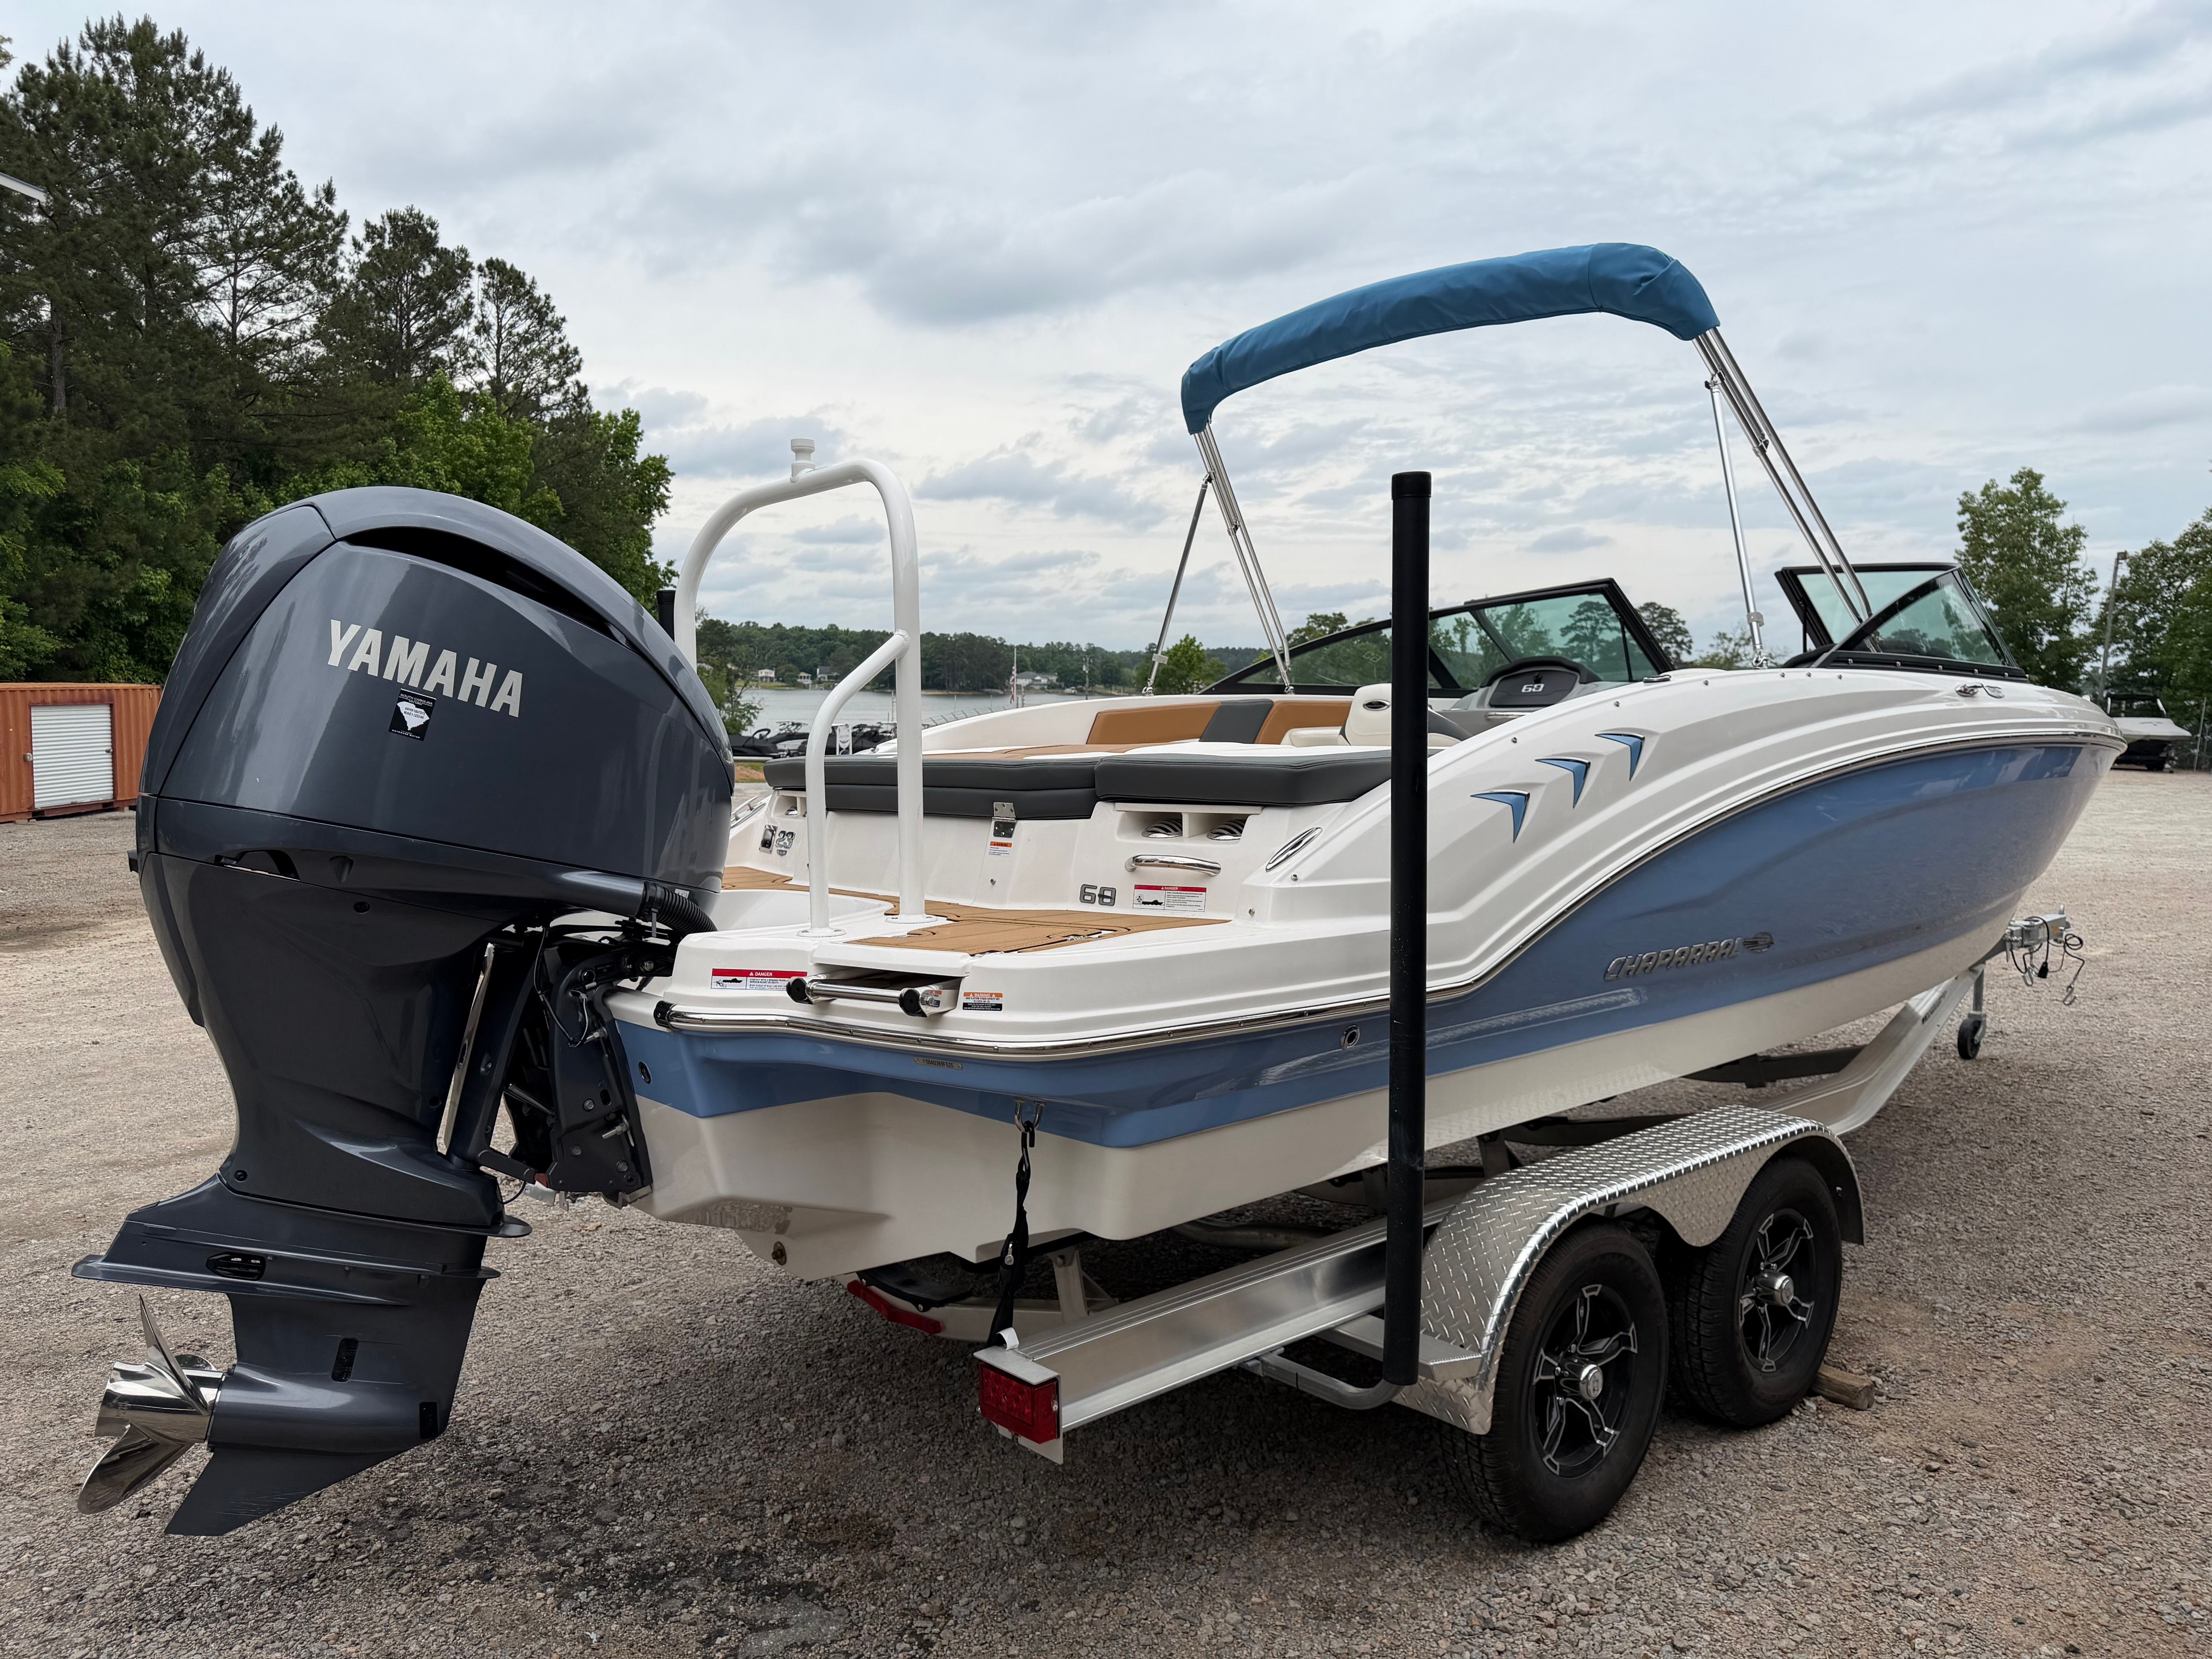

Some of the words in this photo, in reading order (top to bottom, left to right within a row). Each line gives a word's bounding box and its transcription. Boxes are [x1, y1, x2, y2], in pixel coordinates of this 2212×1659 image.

[328, 619, 523, 718] YAMAHA
[775, 830, 795, 849] 23
[1604, 937, 1743, 981] CHAPARRAL
